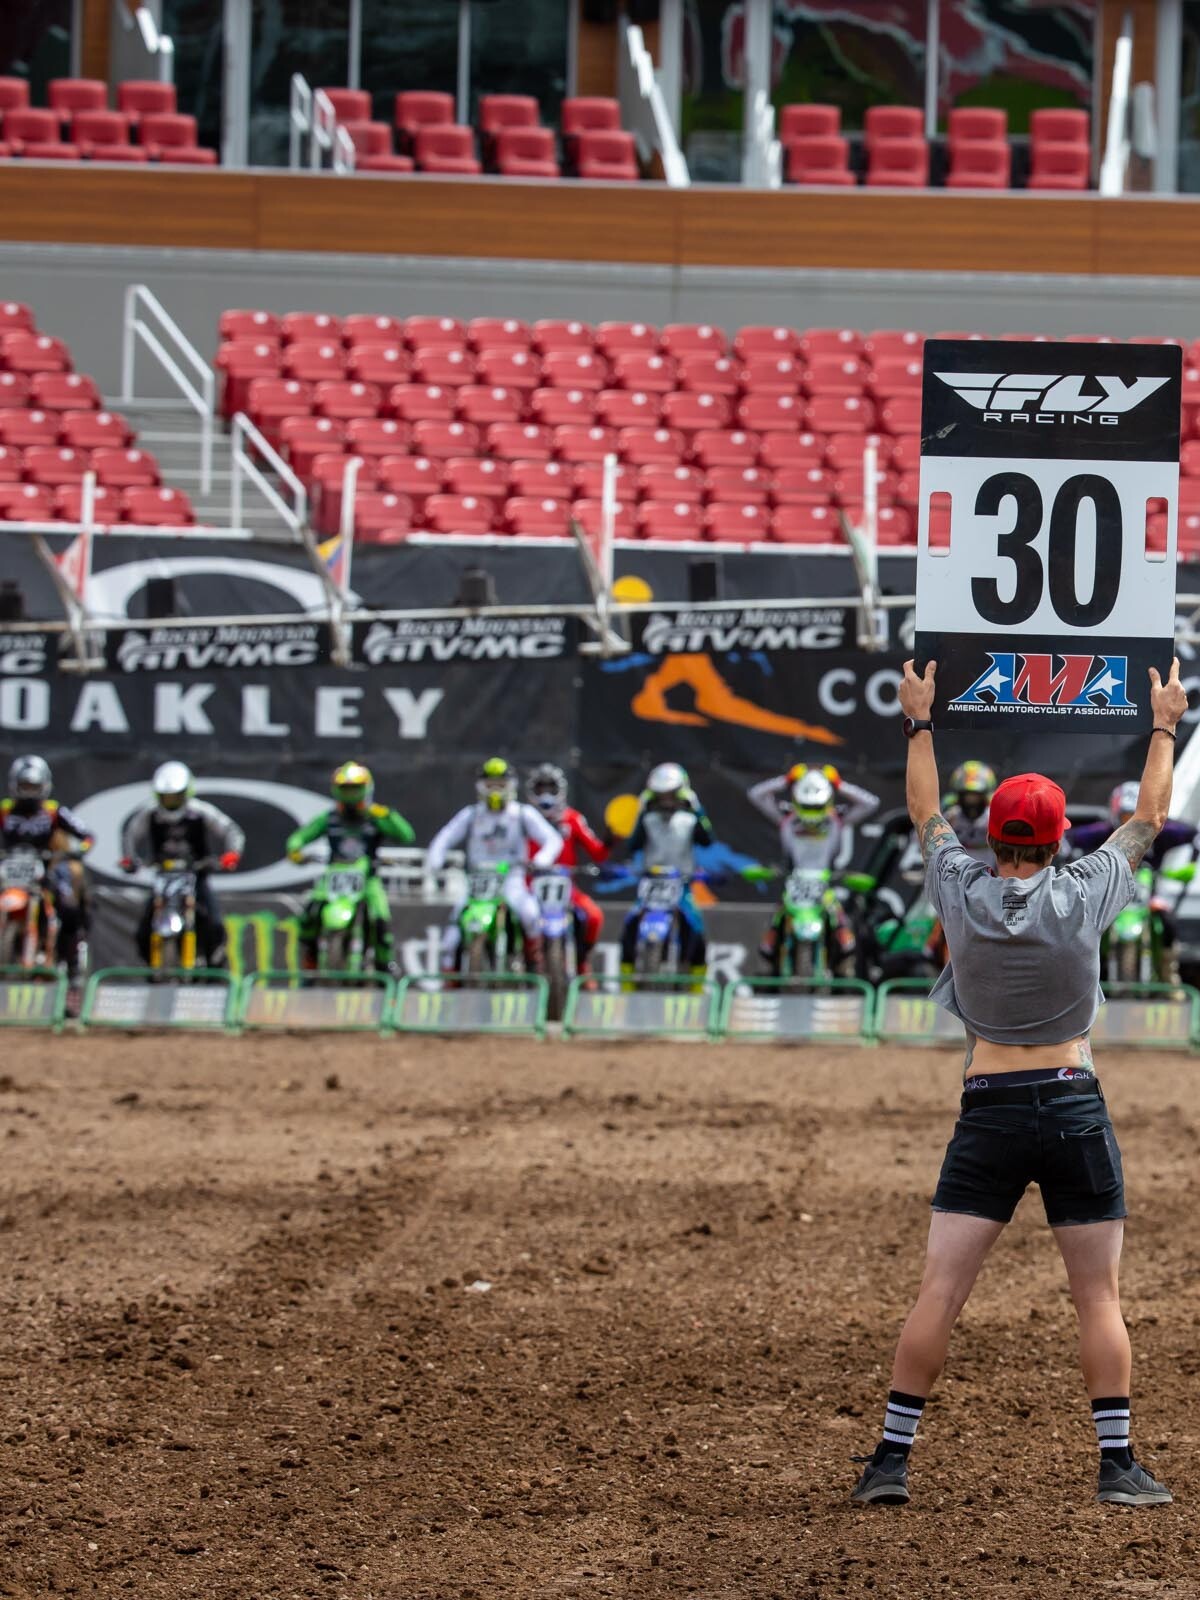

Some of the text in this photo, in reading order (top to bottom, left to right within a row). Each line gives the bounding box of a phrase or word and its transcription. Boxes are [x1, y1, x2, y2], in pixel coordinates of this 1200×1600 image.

[986, 373, 1172, 412] FLY
[983, 412, 1119, 426] RACING
[970, 471, 1123, 628] 30
[948, 651, 1138, 708] AMA
[0, 677, 445, 739] OAKLEY
[947, 703, 1138, 716] AMERICAN MOTORCYCLIST ASSOCIATION
